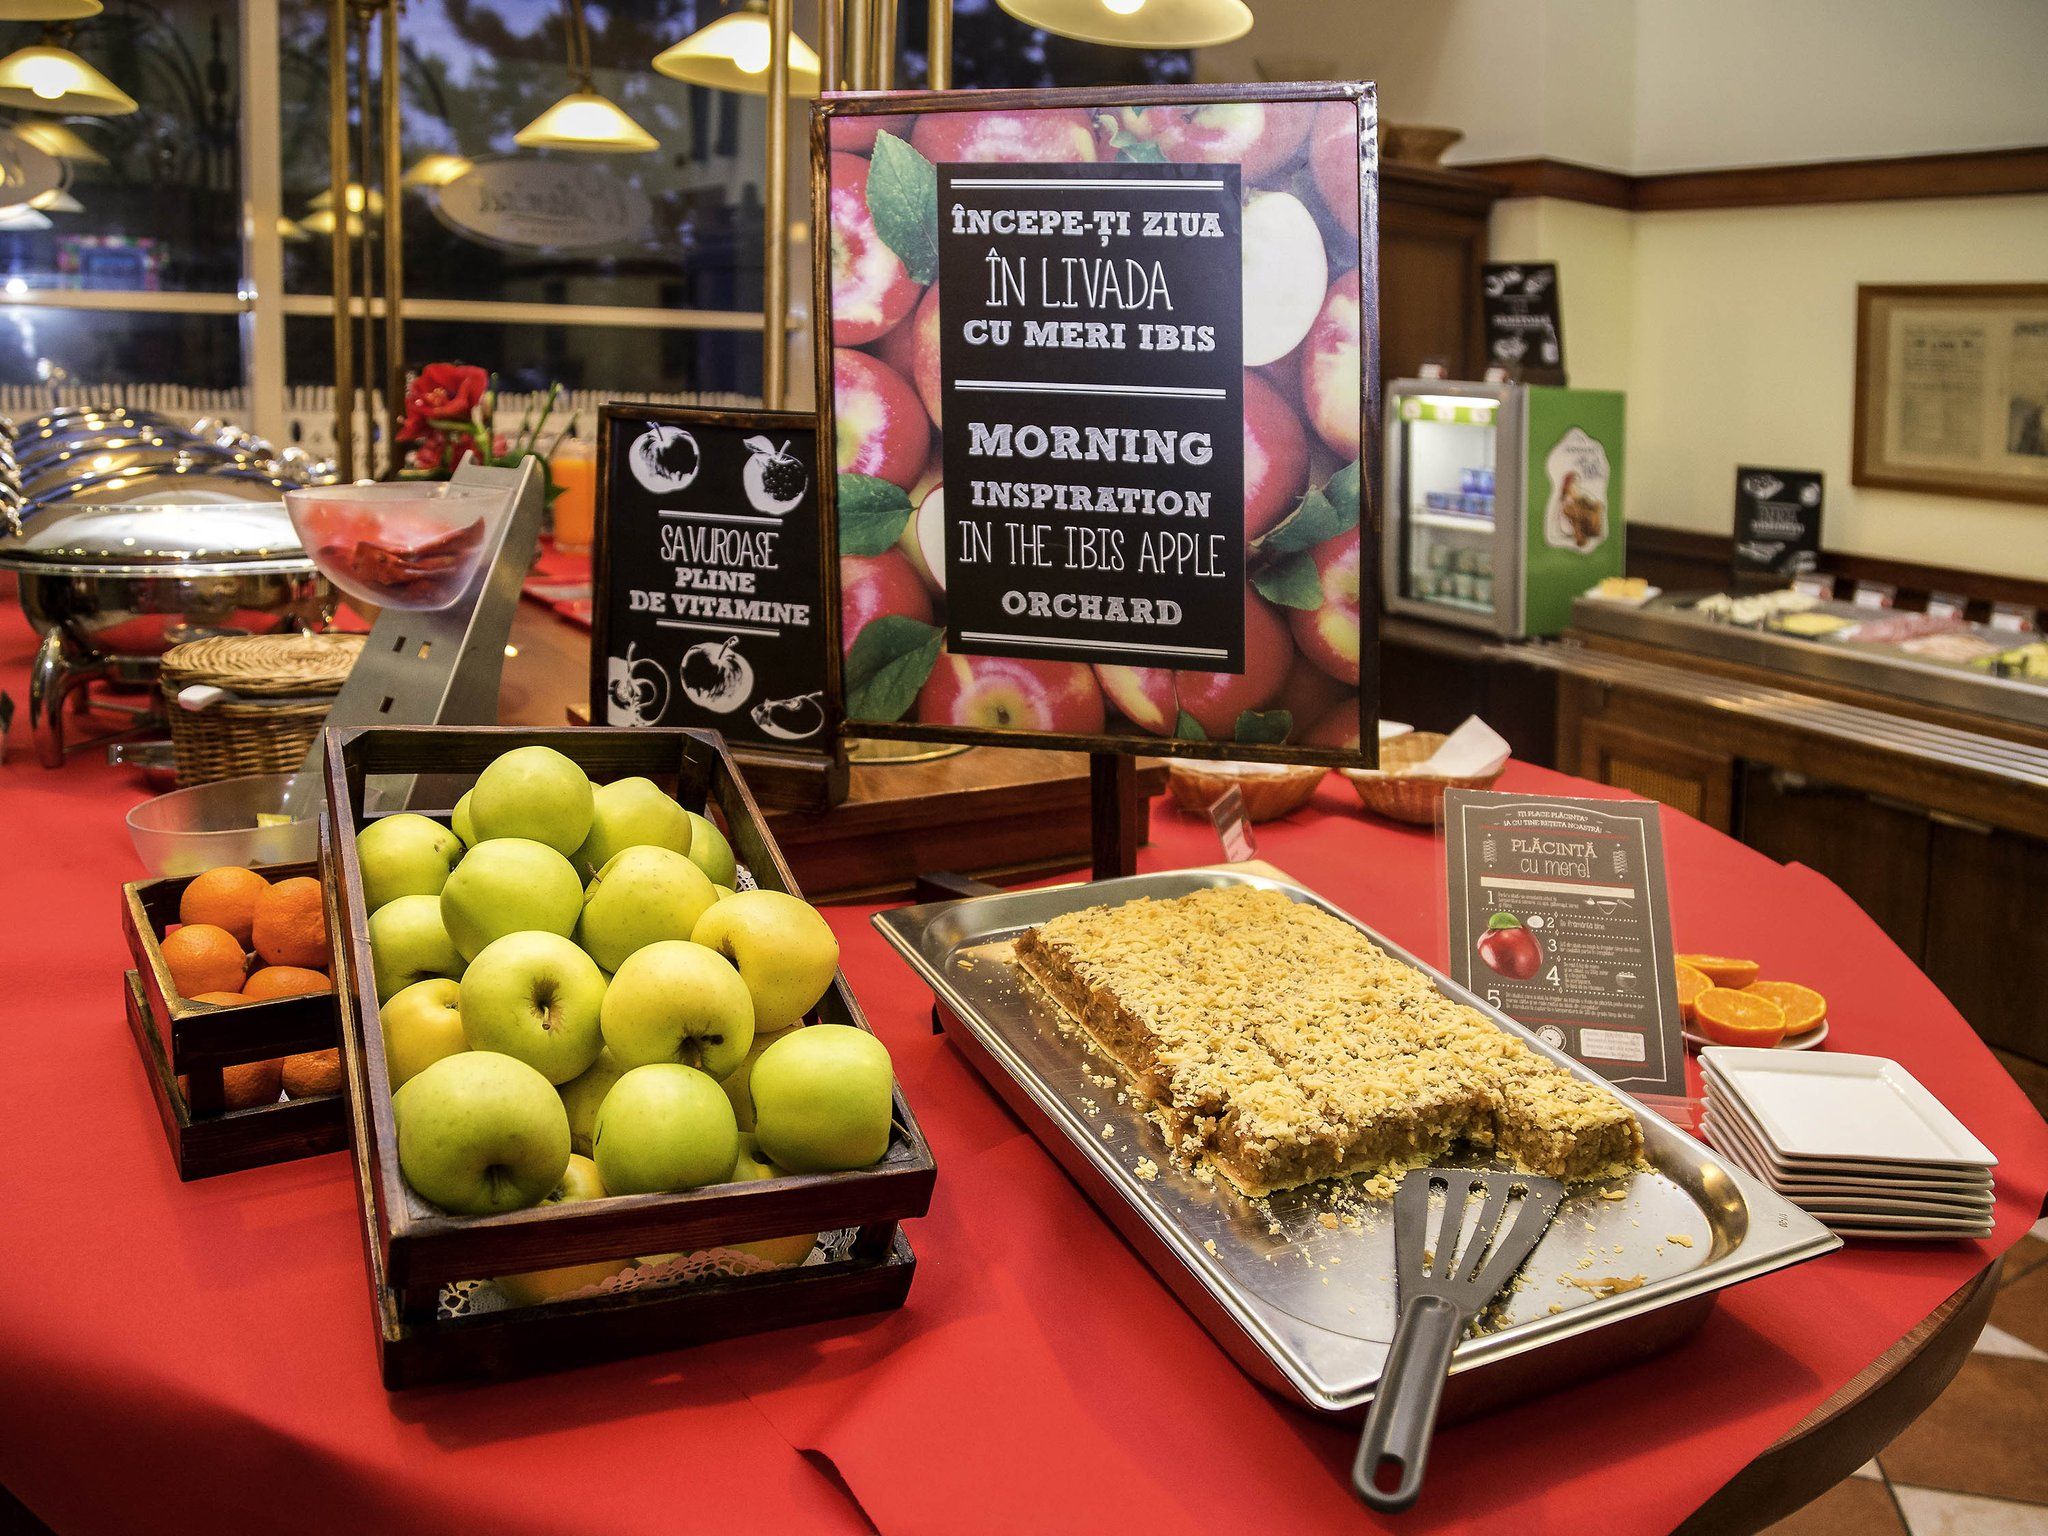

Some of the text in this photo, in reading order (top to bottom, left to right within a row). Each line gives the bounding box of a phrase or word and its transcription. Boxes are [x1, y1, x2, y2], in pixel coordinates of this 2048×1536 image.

[951, 203, 1224, 247] ÎNCEPE-ȚI ZIUA
[985, 247, 1173, 310] ÎN LIVADA
[963, 319, 1216, 352] CU MERI IBIS
[968, 422, 1213, 465] MORNING
[970, 480, 1212, 518] INSPIRATION
[660, 524, 779, 569] SAVUROASE
[959, 520, 1226, 577] IN THE IBIS APPLE
[675, 566, 756, 594] PLINE
[629, 589, 810, 626] DE VITAMINE
[1001, 590, 1183, 626] ORCHARD
[1511, 837, 1598, 859] PLĂCINTĂ
[1520, 858, 1591, 879] cu mere!
[1487, 890, 1495, 905] 1
[1546, 917, 1555, 928] 2
[1548, 939, 1558, 952] 3
[1546, 965, 1561, 986] 4
[1487, 989, 1502, 1010] 5
